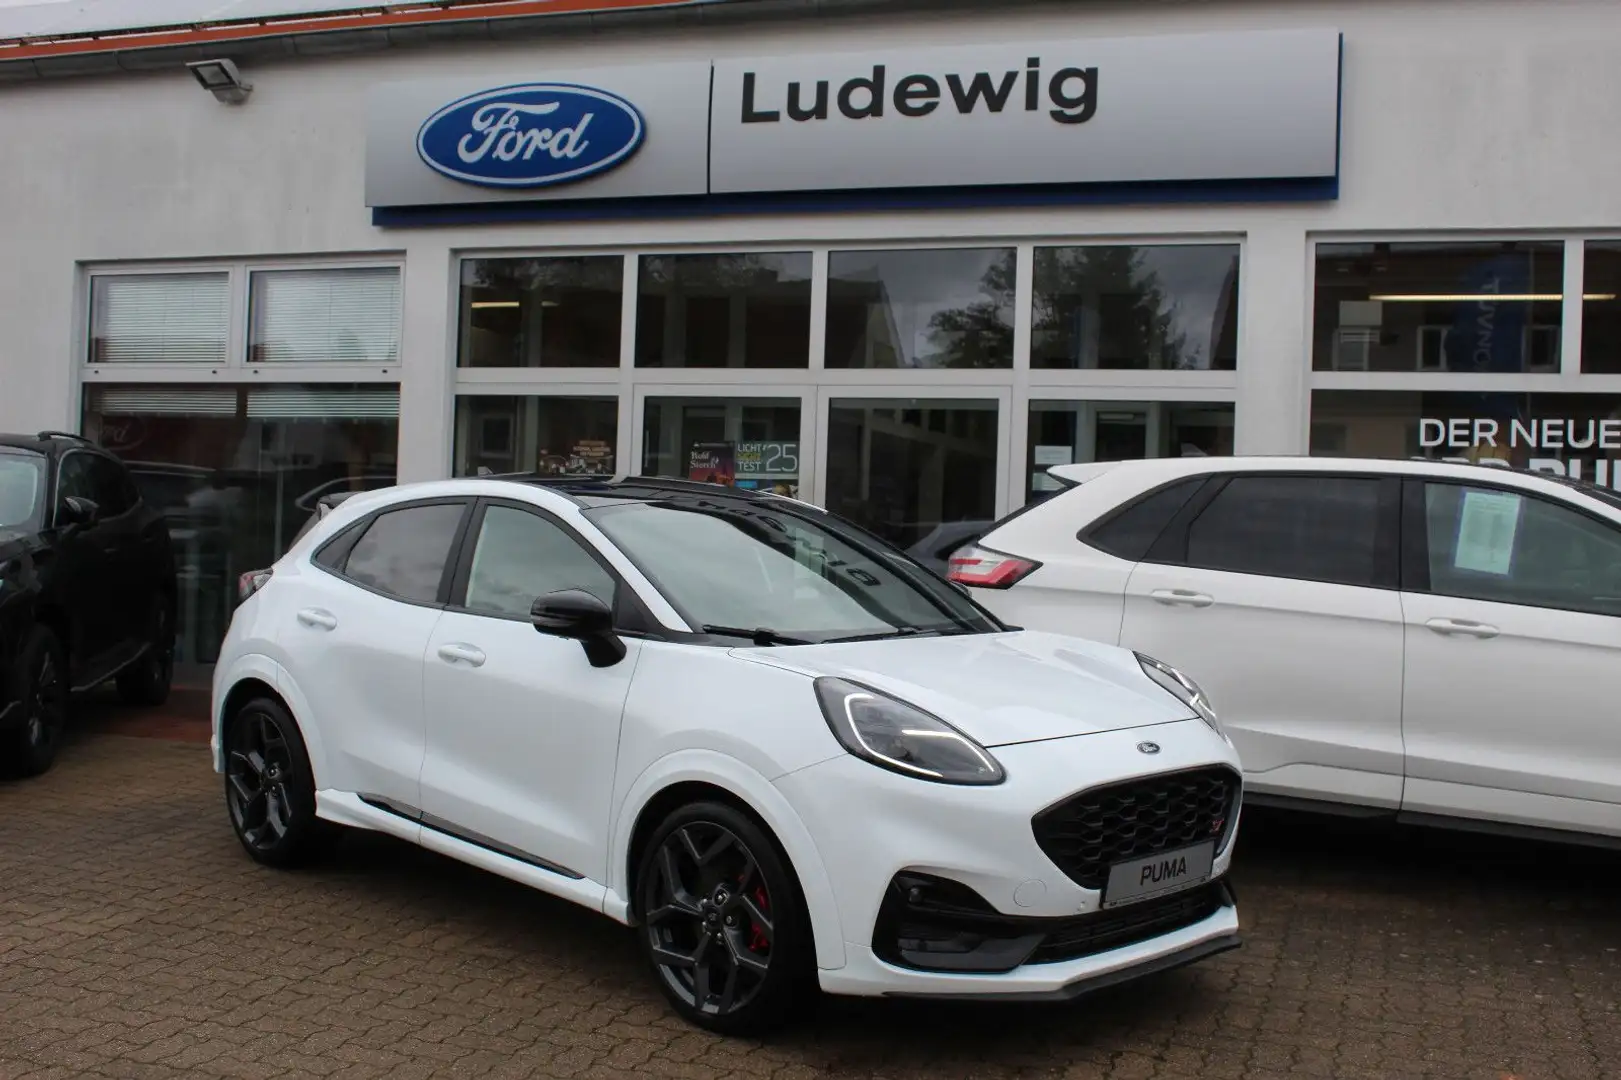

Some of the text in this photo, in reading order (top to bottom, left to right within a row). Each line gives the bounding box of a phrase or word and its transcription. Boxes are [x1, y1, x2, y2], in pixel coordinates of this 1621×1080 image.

[740, 57, 1099, 124] Ludewig
[457, 101, 591, 163] Ford
[1419, 418, 1621, 449] DER NEUE
[738, 461, 762, 472] TEST
[1140, 856, 1187, 886] PUMA
